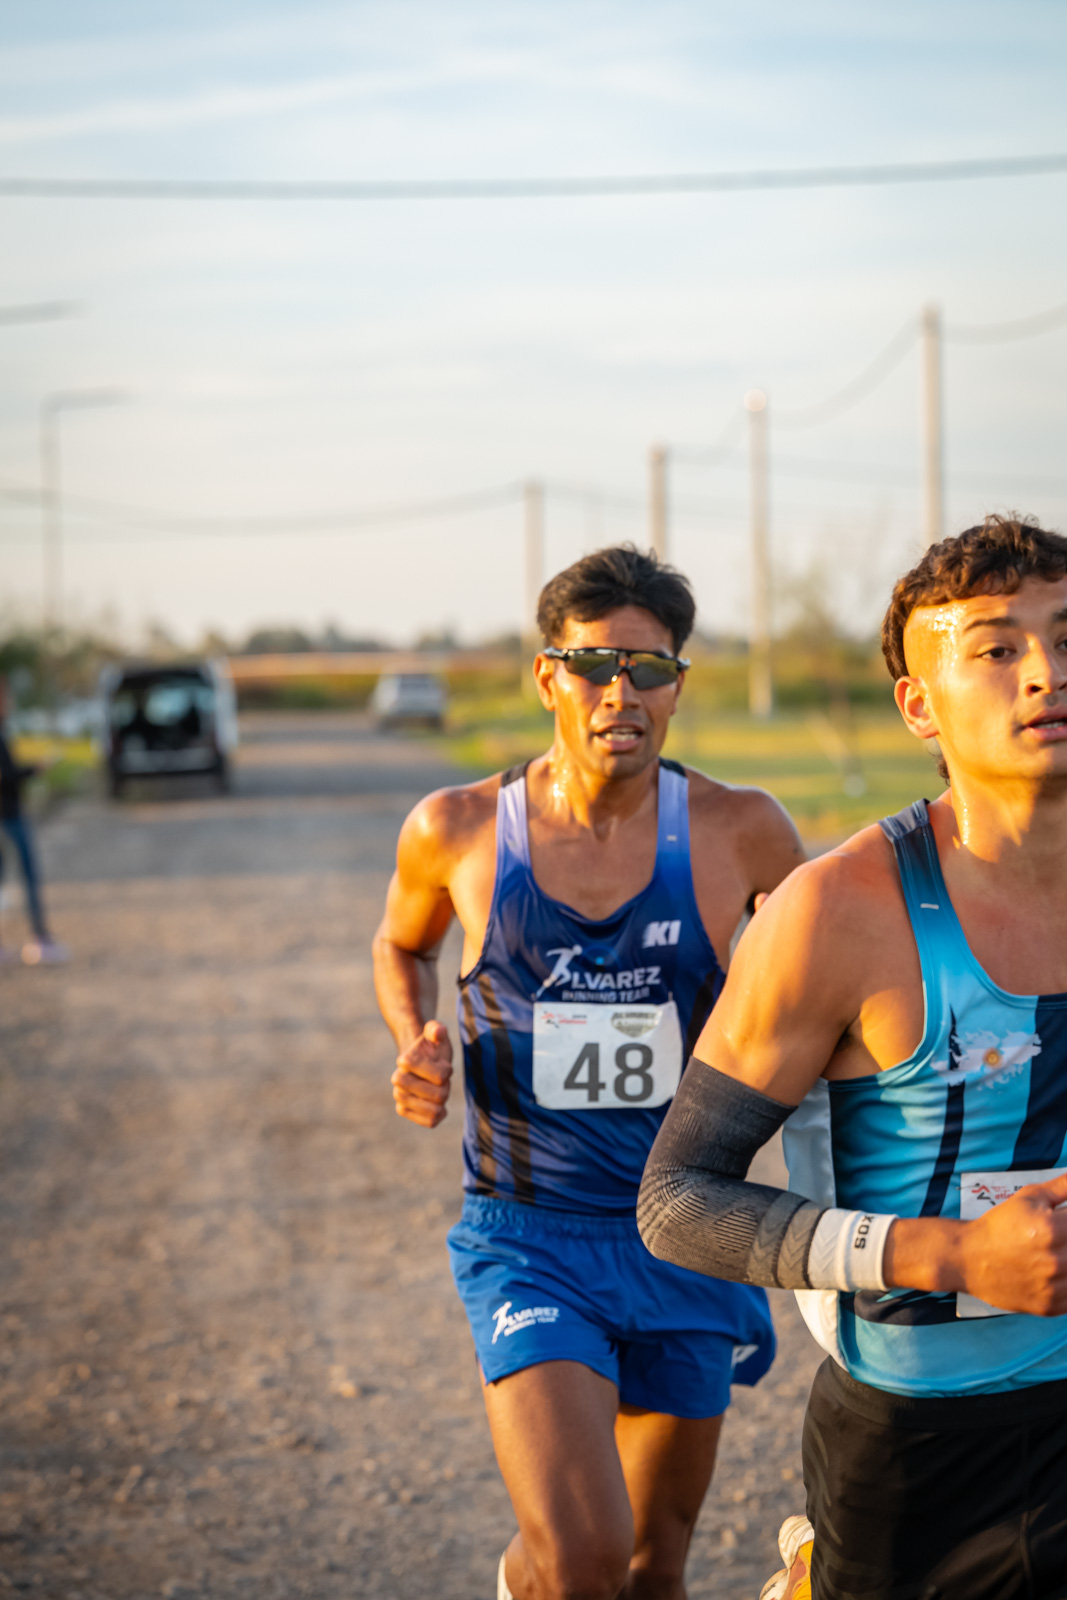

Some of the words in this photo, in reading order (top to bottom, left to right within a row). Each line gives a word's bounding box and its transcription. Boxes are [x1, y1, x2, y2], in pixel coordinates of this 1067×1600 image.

[620, 986, 649, 1002] TEAM
[563, 1042, 655, 1103] 48
[854, 1214, 875, 1250] SOX
